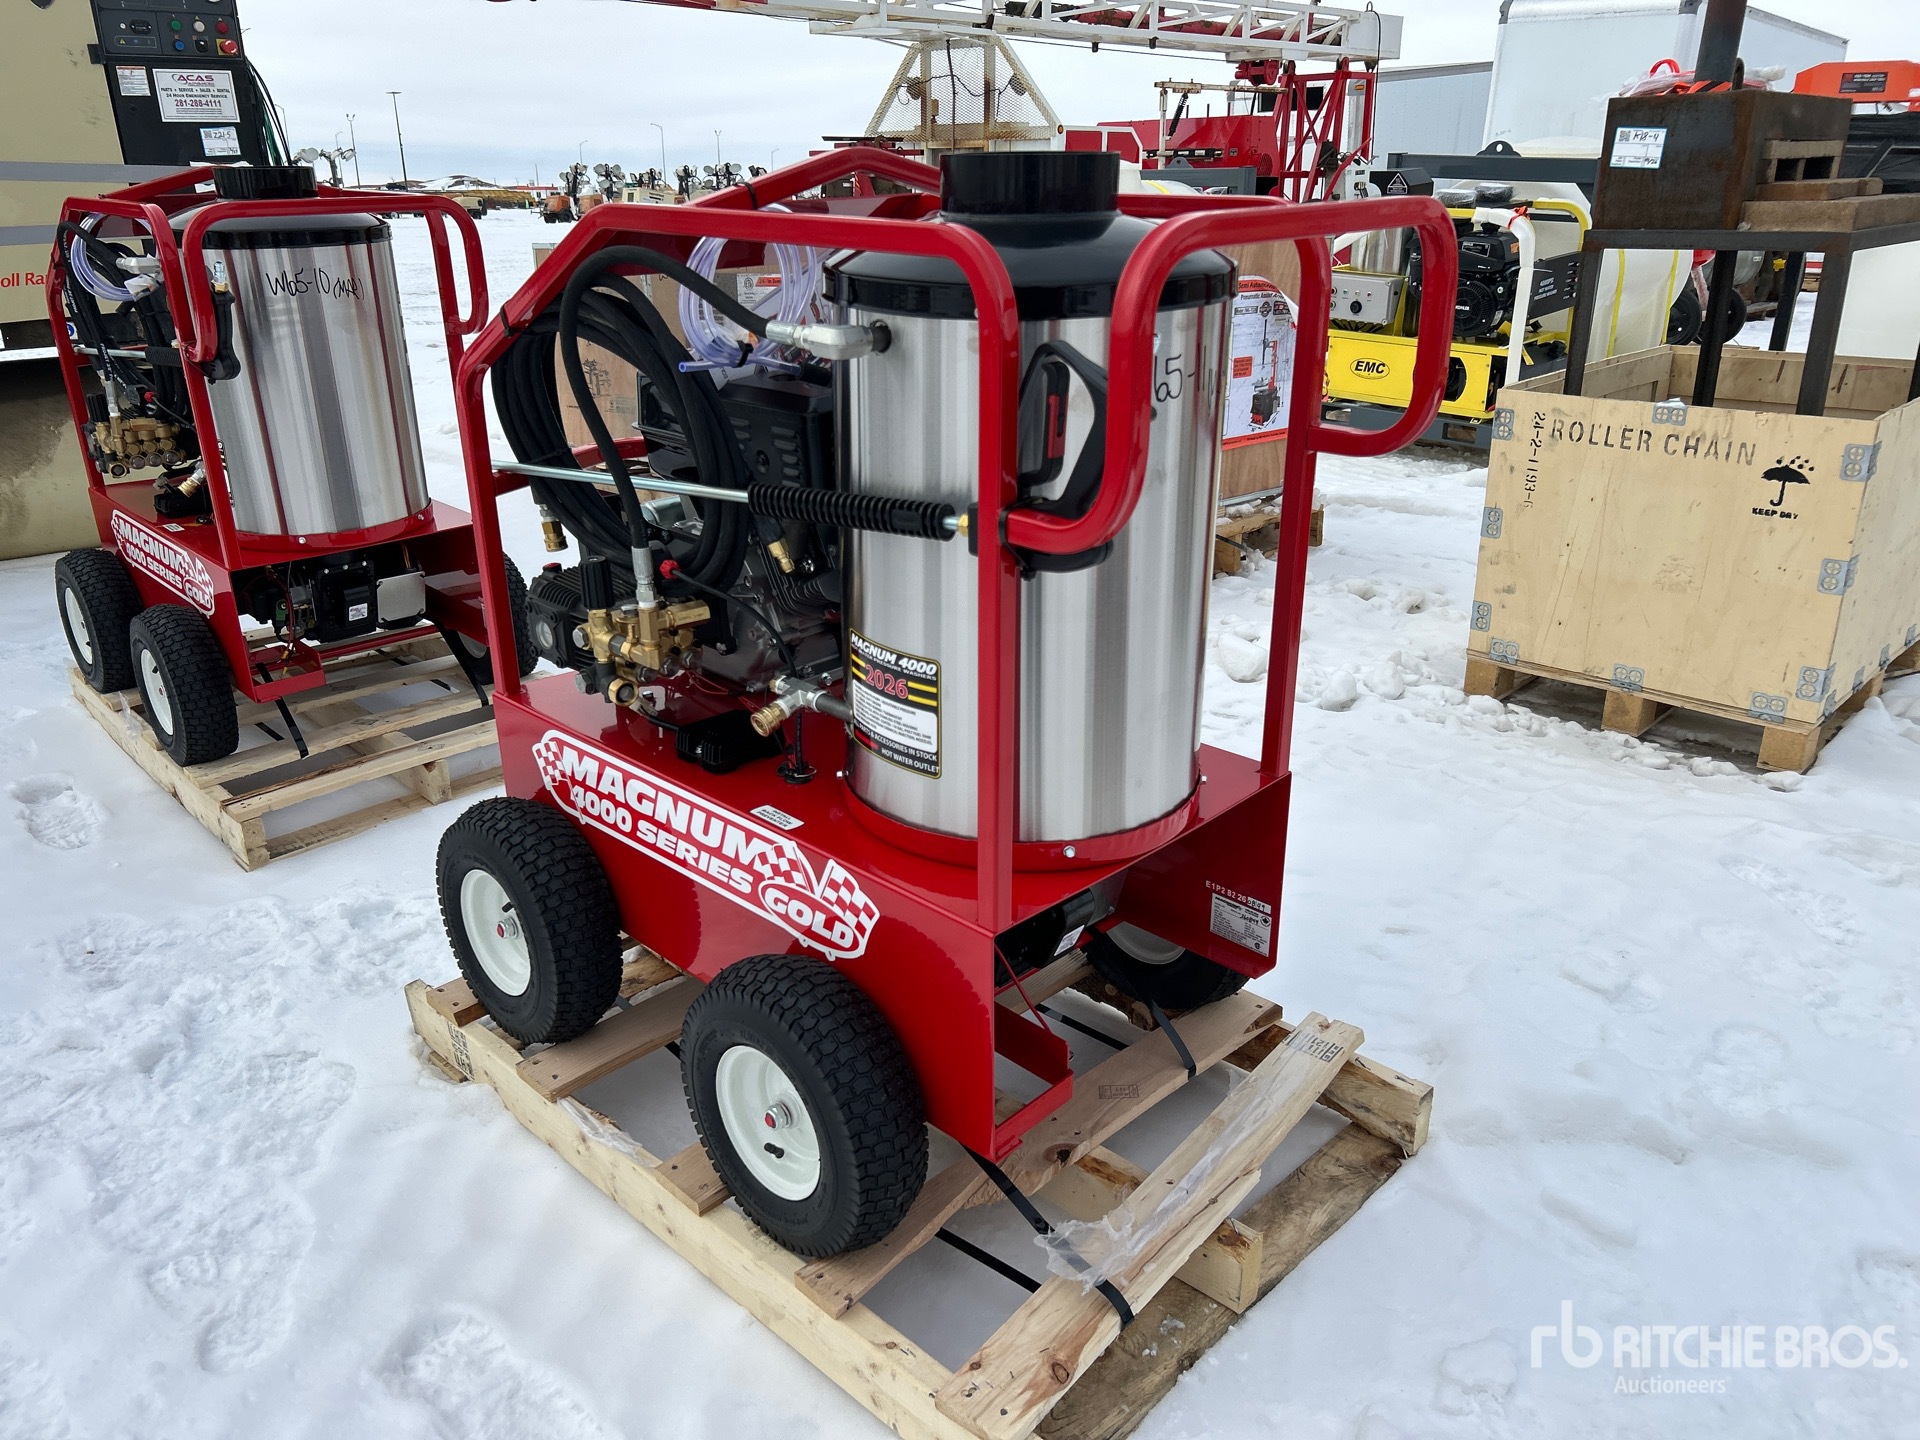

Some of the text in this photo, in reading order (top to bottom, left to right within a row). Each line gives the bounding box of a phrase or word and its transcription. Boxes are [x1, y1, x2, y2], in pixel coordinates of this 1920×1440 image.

[177, 74, 215, 82] ACAS
[175, 99, 222, 108] 281-288-4111
[25, 272, 47, 286] Ra
[266, 267, 331, 297] W65-10
[1354, 360, 1386, 374] EMC
[1551, 418, 1757, 467] ROLLER CHAIN
[1752, 507, 1799, 520] KEEP DRY
[118, 518, 186, 575] MAGNUM
[125, 542, 183, 589] 4000 SERIES
[185, 582, 212, 608] GOLD
[851, 632, 938, 676] MAGNUM 4000
[865, 663, 909, 699] 2026
[874, 732, 908, 754] ACCESSORIES
[915, 749, 938, 762] STOCK
[881, 747, 940, 773] HOT WATER OUTLET
[562, 745, 768, 867] MAGNUM
[571, 784, 755, 895] 4000 SERIES
[764, 887, 855, 949] GOLD
